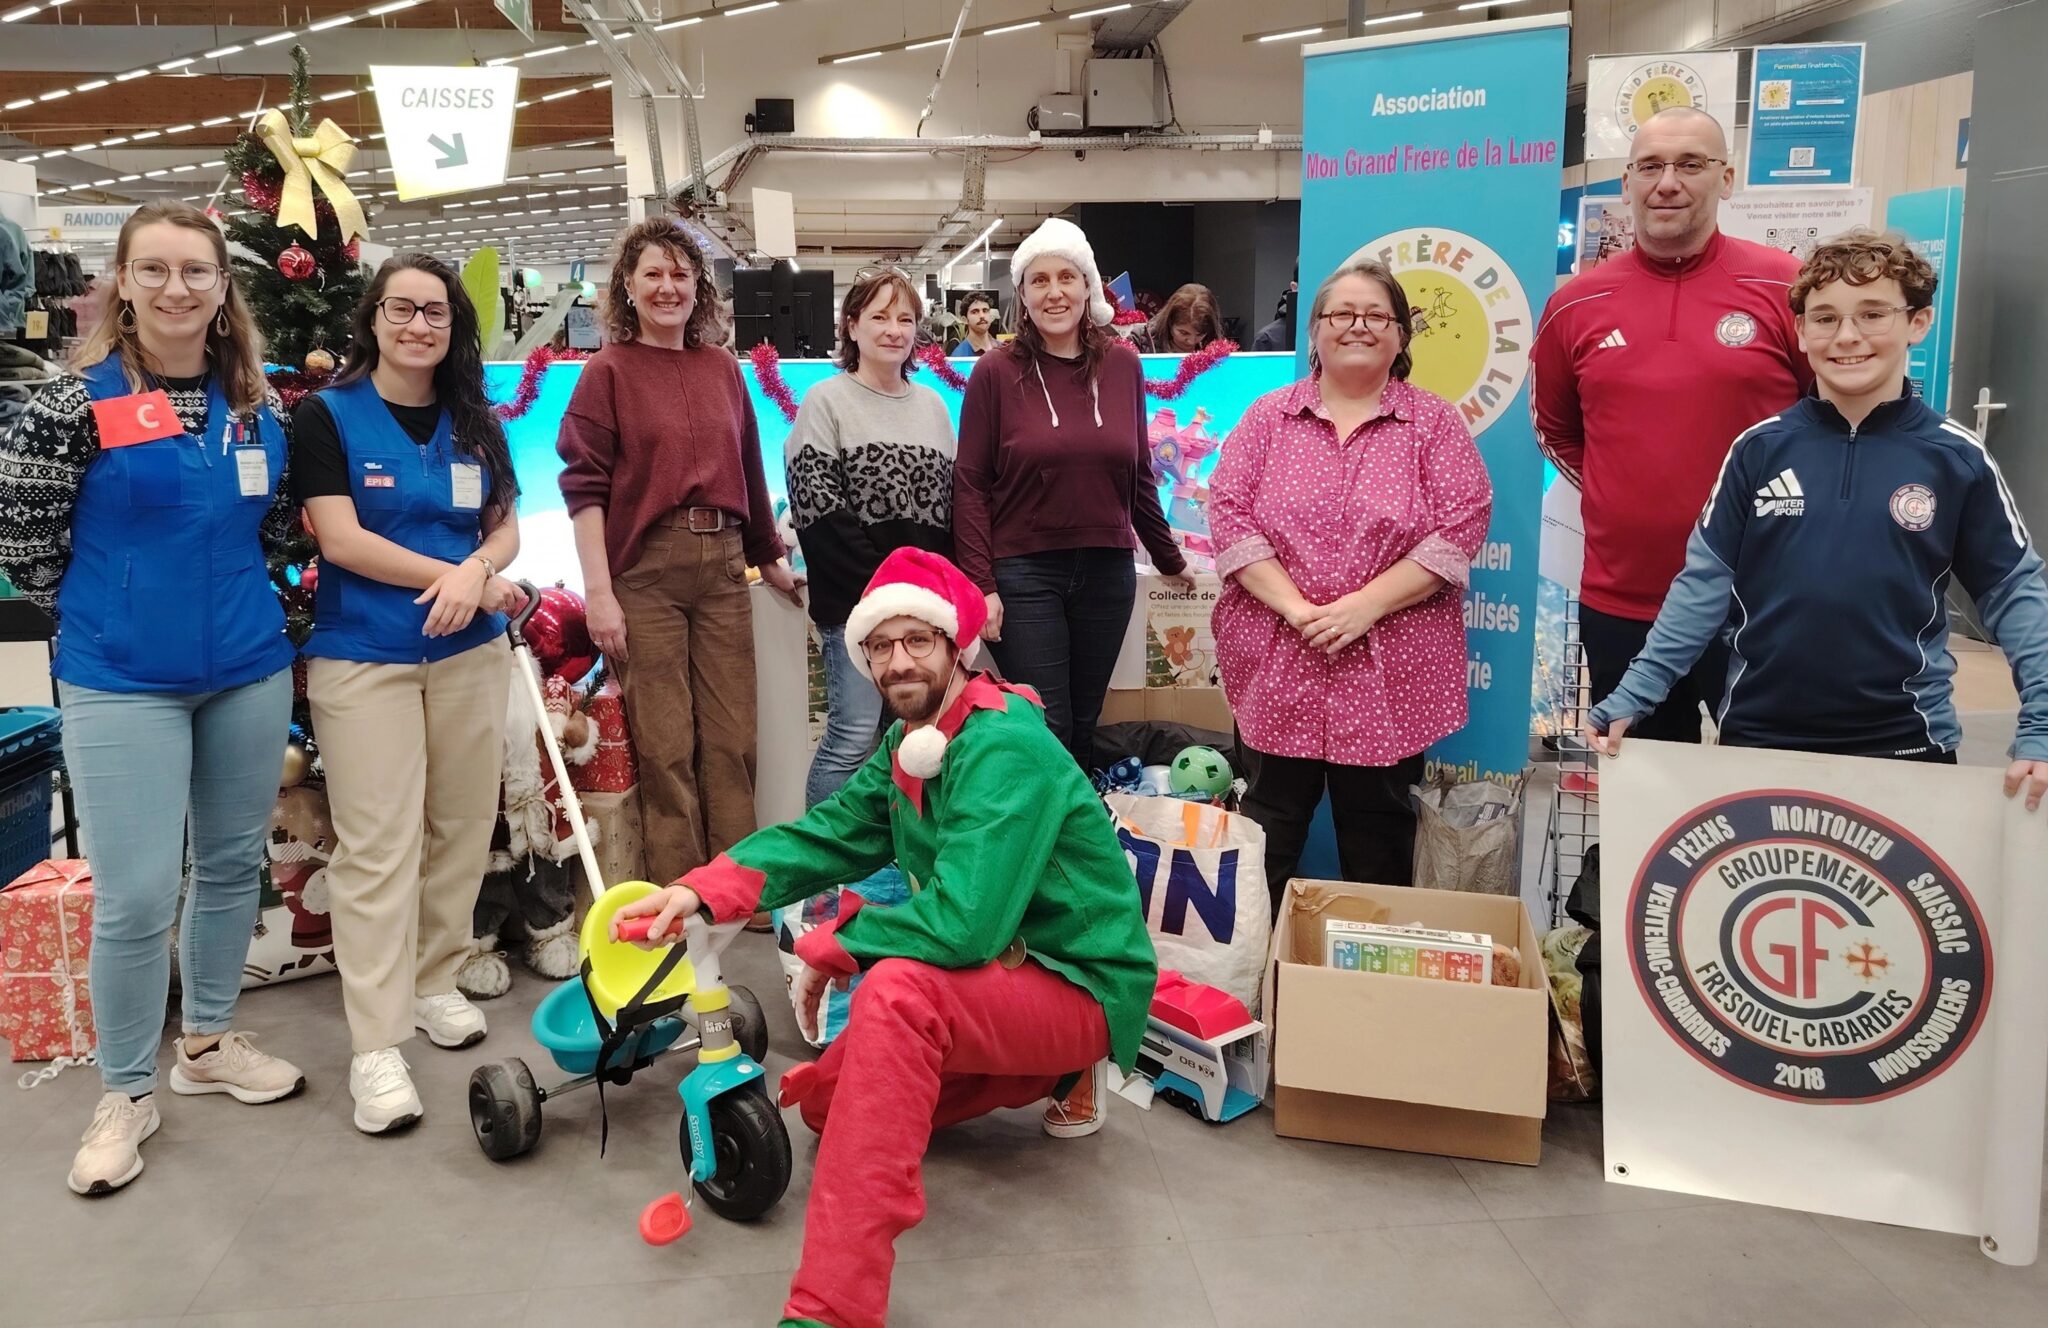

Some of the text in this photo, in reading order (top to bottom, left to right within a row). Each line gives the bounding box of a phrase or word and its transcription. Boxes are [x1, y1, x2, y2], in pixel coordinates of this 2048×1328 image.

[401, 87, 494, 109] CAISSES
[1371, 85, 1486, 117] Association
[1306, 152, 1338, 180] Mon
[1344, 145, 1398, 178] Grand
[1456, 140, 1479, 169] de
[1485, 137, 1502, 166] la
[1509, 135, 1557, 165] Lune
[1730, 202, 1750, 210] Vous
[1753, 201, 1794, 210] souhaitez
[1808, 199, 1835, 208] savoir
[1836, 199, 1855, 208] plus
[1858, 199, 1863, 207] ?
[1774, 211, 1800, 219] visiter
[1802, 211, 1824, 219] notre
[1826, 210, 1842, 218] site
[573, 263, 581, 282] 4
[1377, 233, 1474, 273] FRÈRE
[1473, 266, 1511, 308] DE
[1494, 318, 1521, 354] LA
[136, 403, 160, 429] C
[366, 477, 381, 486] EPI
[1773, 507, 1805, 517] SPORT
[1775, 499, 1805, 508] INTER
[1149, 591, 1216, 601] Collecte de
[1463, 591, 1520, 633] alisés
[1668, 814, 1736, 868] PEZENS
[1769, 804, 1894, 862] MONTOLIEU
[1717, 847, 1891, 908] GROUPEMENT
[1905, 871, 1970, 955] SAISSAC
[1643, 880, 1733, 1059] VENTENAC-CABARDES
[1694, 960, 1914, 1048] FRESQUEL-CABARDES
[1867, 977, 1972, 1084] MOUSSOULENS
[1773, 1062, 1826, 1091] 2018
[690, 1114, 705, 1159] Smoby
